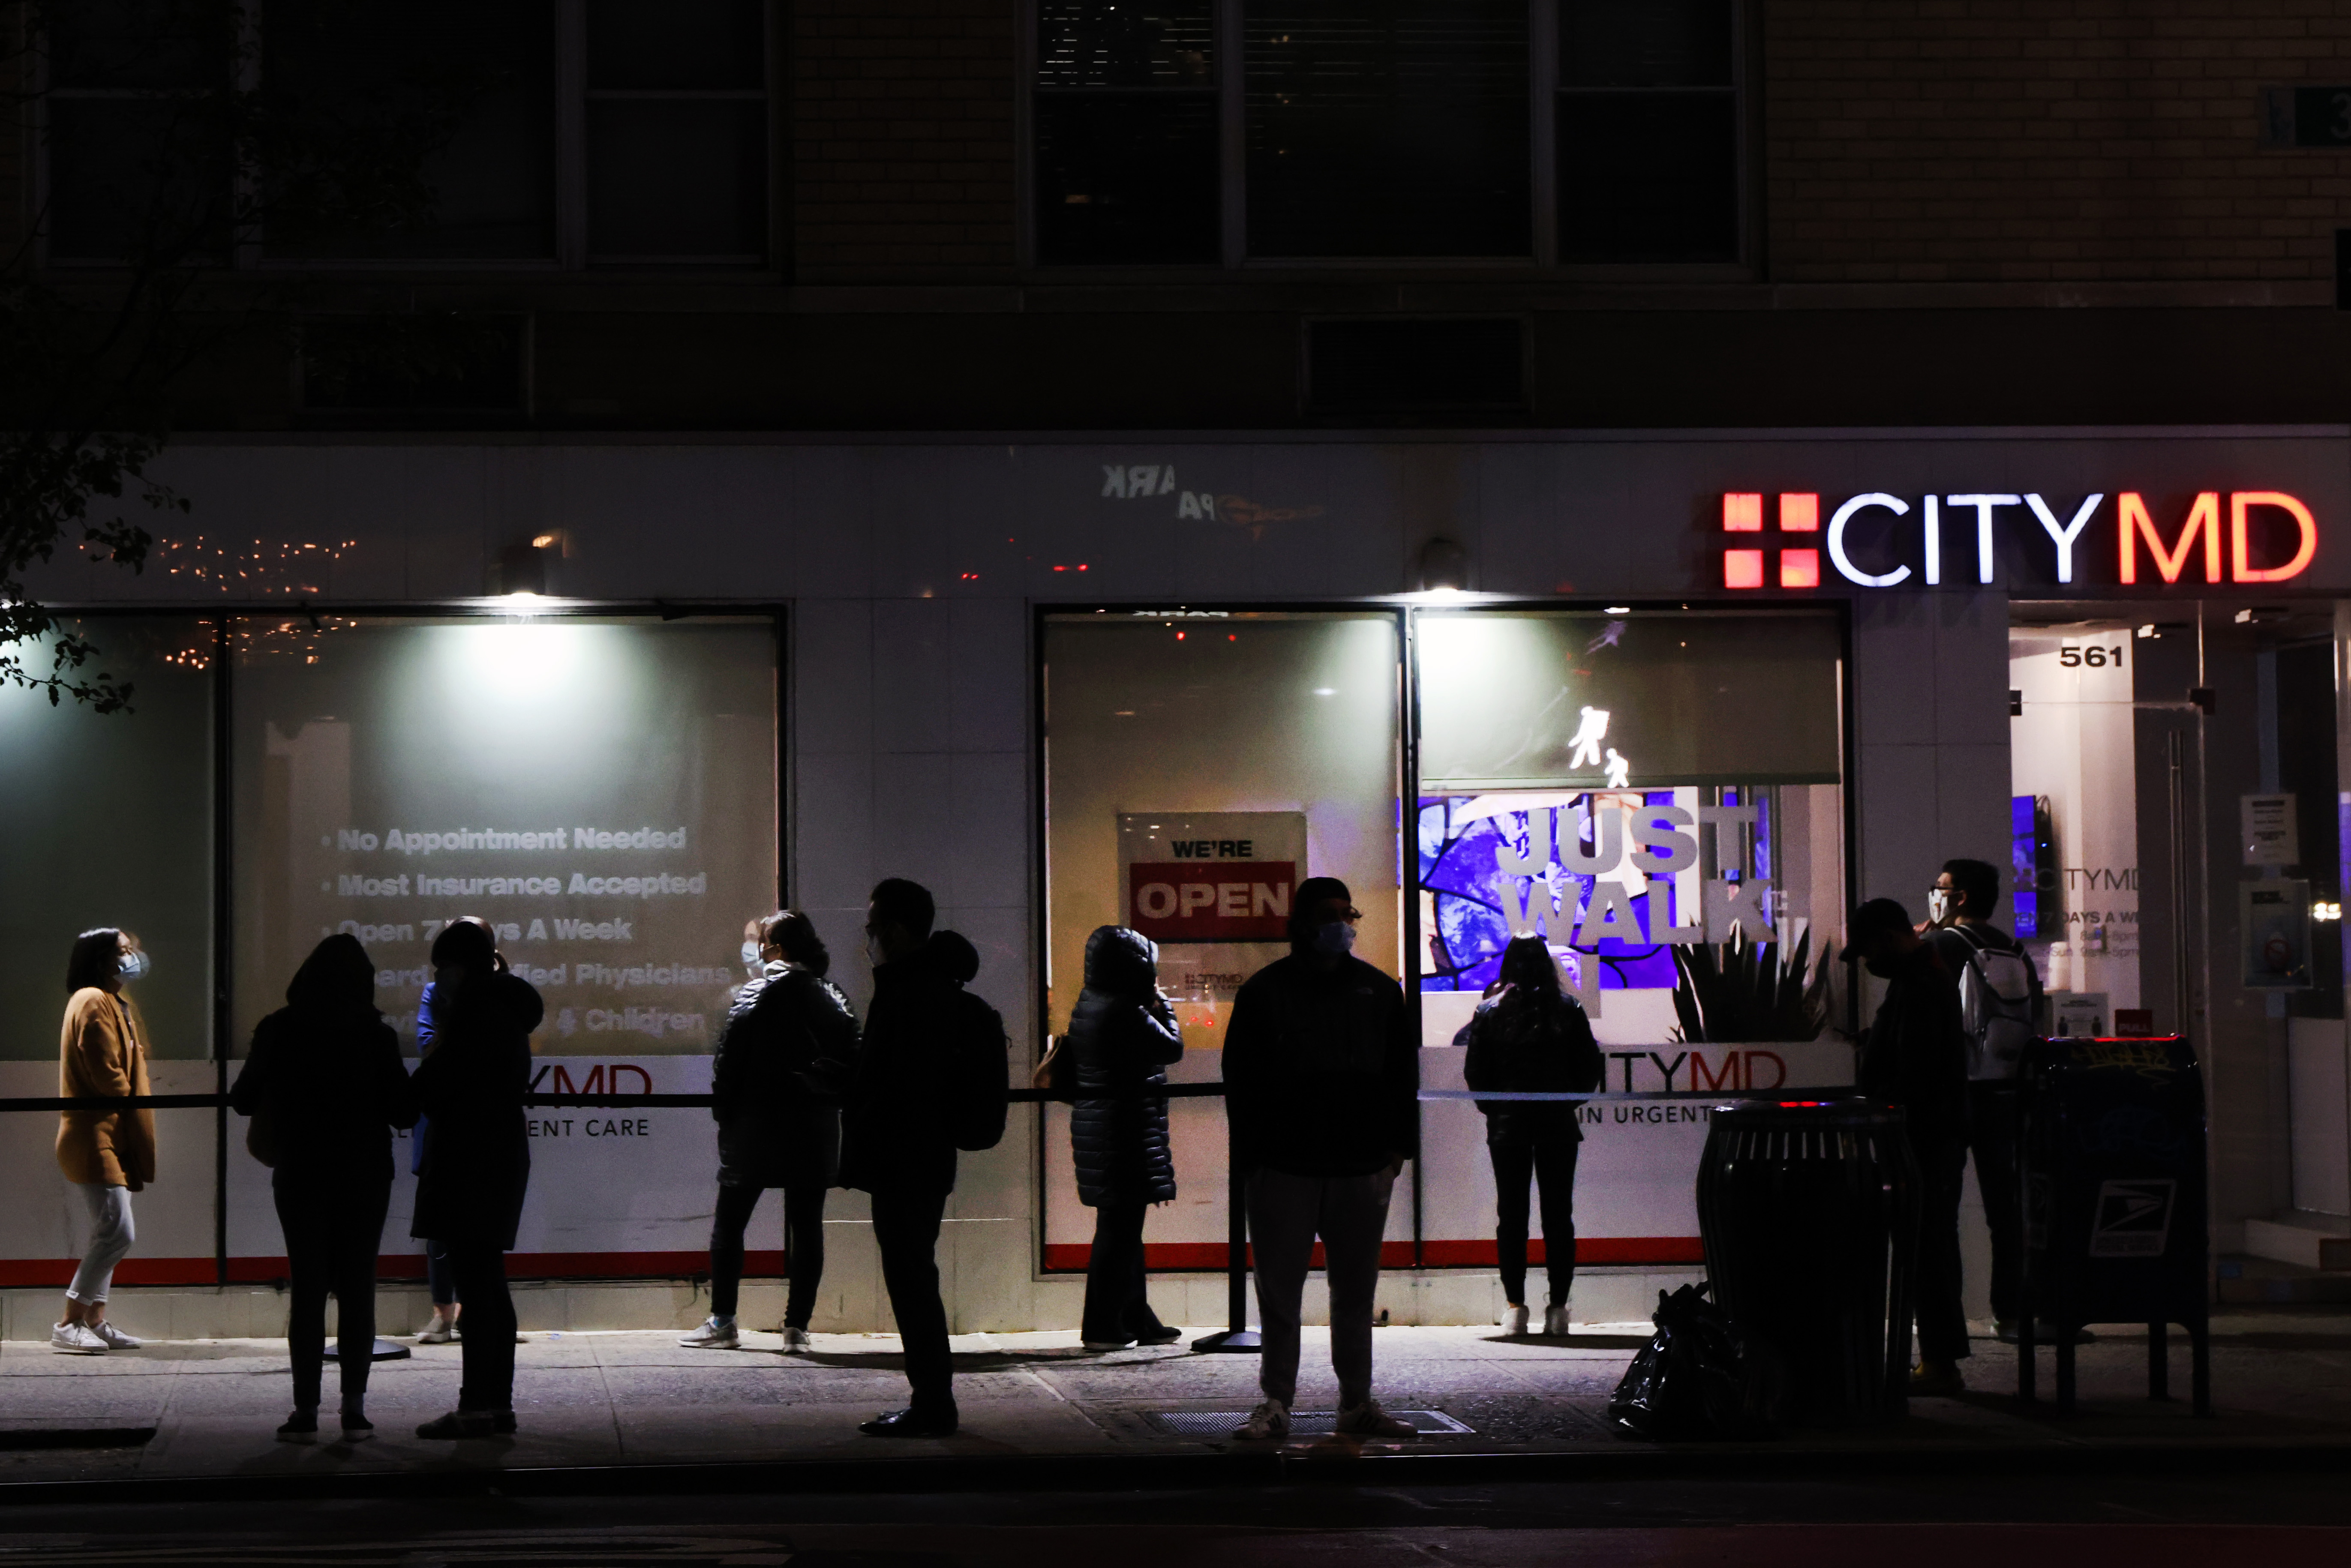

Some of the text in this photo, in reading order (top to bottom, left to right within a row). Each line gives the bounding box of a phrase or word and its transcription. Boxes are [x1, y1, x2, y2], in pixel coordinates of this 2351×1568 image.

[1827, 492, 2318, 588] CITYMD
[2060, 646, 2123, 668] 561
[337, 827, 687, 855] No Appointment Needed
[1171, 840, 1252, 857] WE'RE
[1495, 805, 1758, 876] JUST
[338, 872, 707, 899] Most Insurance Accepted
[1137, 882, 1289, 919] OPEN
[1498, 878, 1777, 945] WALK
[527, 918, 548, 940] A
[554, 917, 633, 940] Week
[576, 963, 732, 990] Physicians
[586, 1007, 705, 1031] Children
[585, 1119, 649, 1137] CARE
[1614, 1106, 1711, 1123] URGENT
